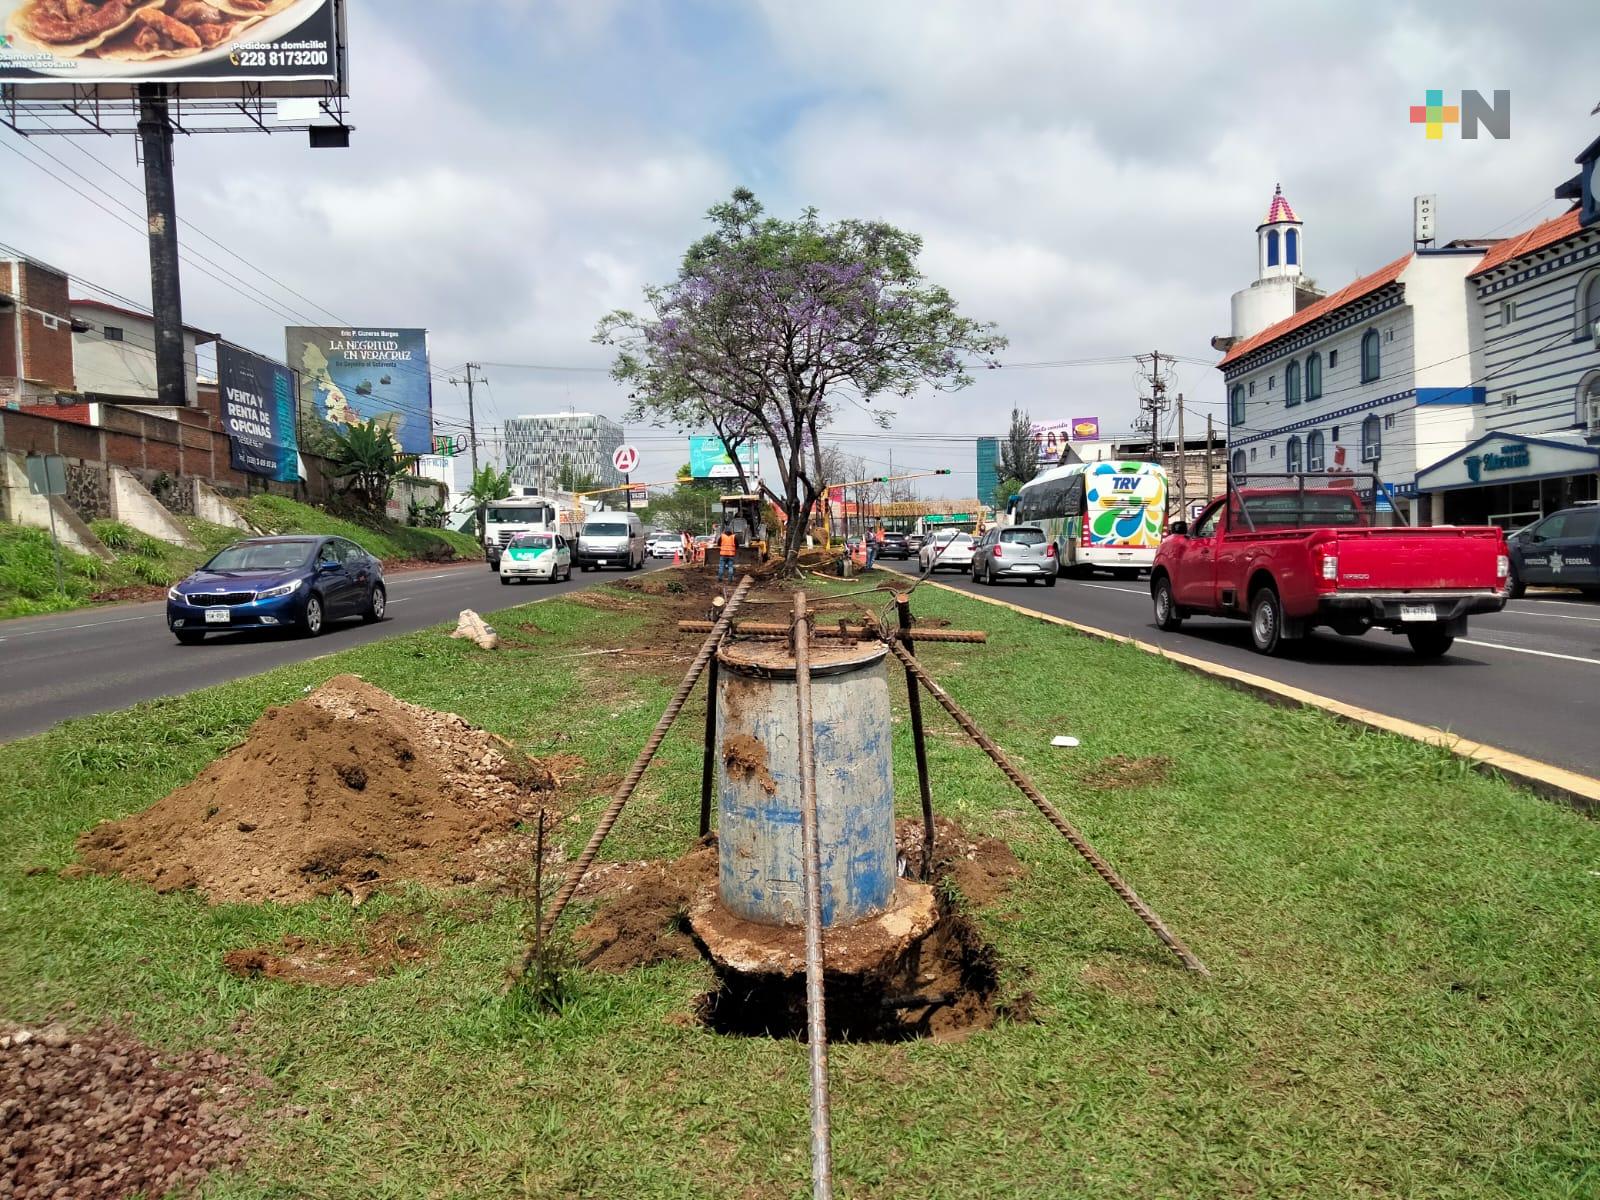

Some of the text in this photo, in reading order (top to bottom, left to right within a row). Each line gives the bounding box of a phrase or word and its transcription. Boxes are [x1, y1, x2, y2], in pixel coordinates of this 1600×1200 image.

[281, 40, 327, 49] domicilio!
[240, 50, 328, 66] 228 8173200
[329, 340, 398, 351] LA NEGRITUD
[343, 350, 412, 360] EN VERACRUZ
[226, 386, 264, 409] VENTA Y
[227, 402, 271, 425] RENTA DE
[230, 418, 272, 439] OFICINAS
[1112, 477, 1141, 490] TRV
[1565, 557, 1592, 565] FEDERAL
